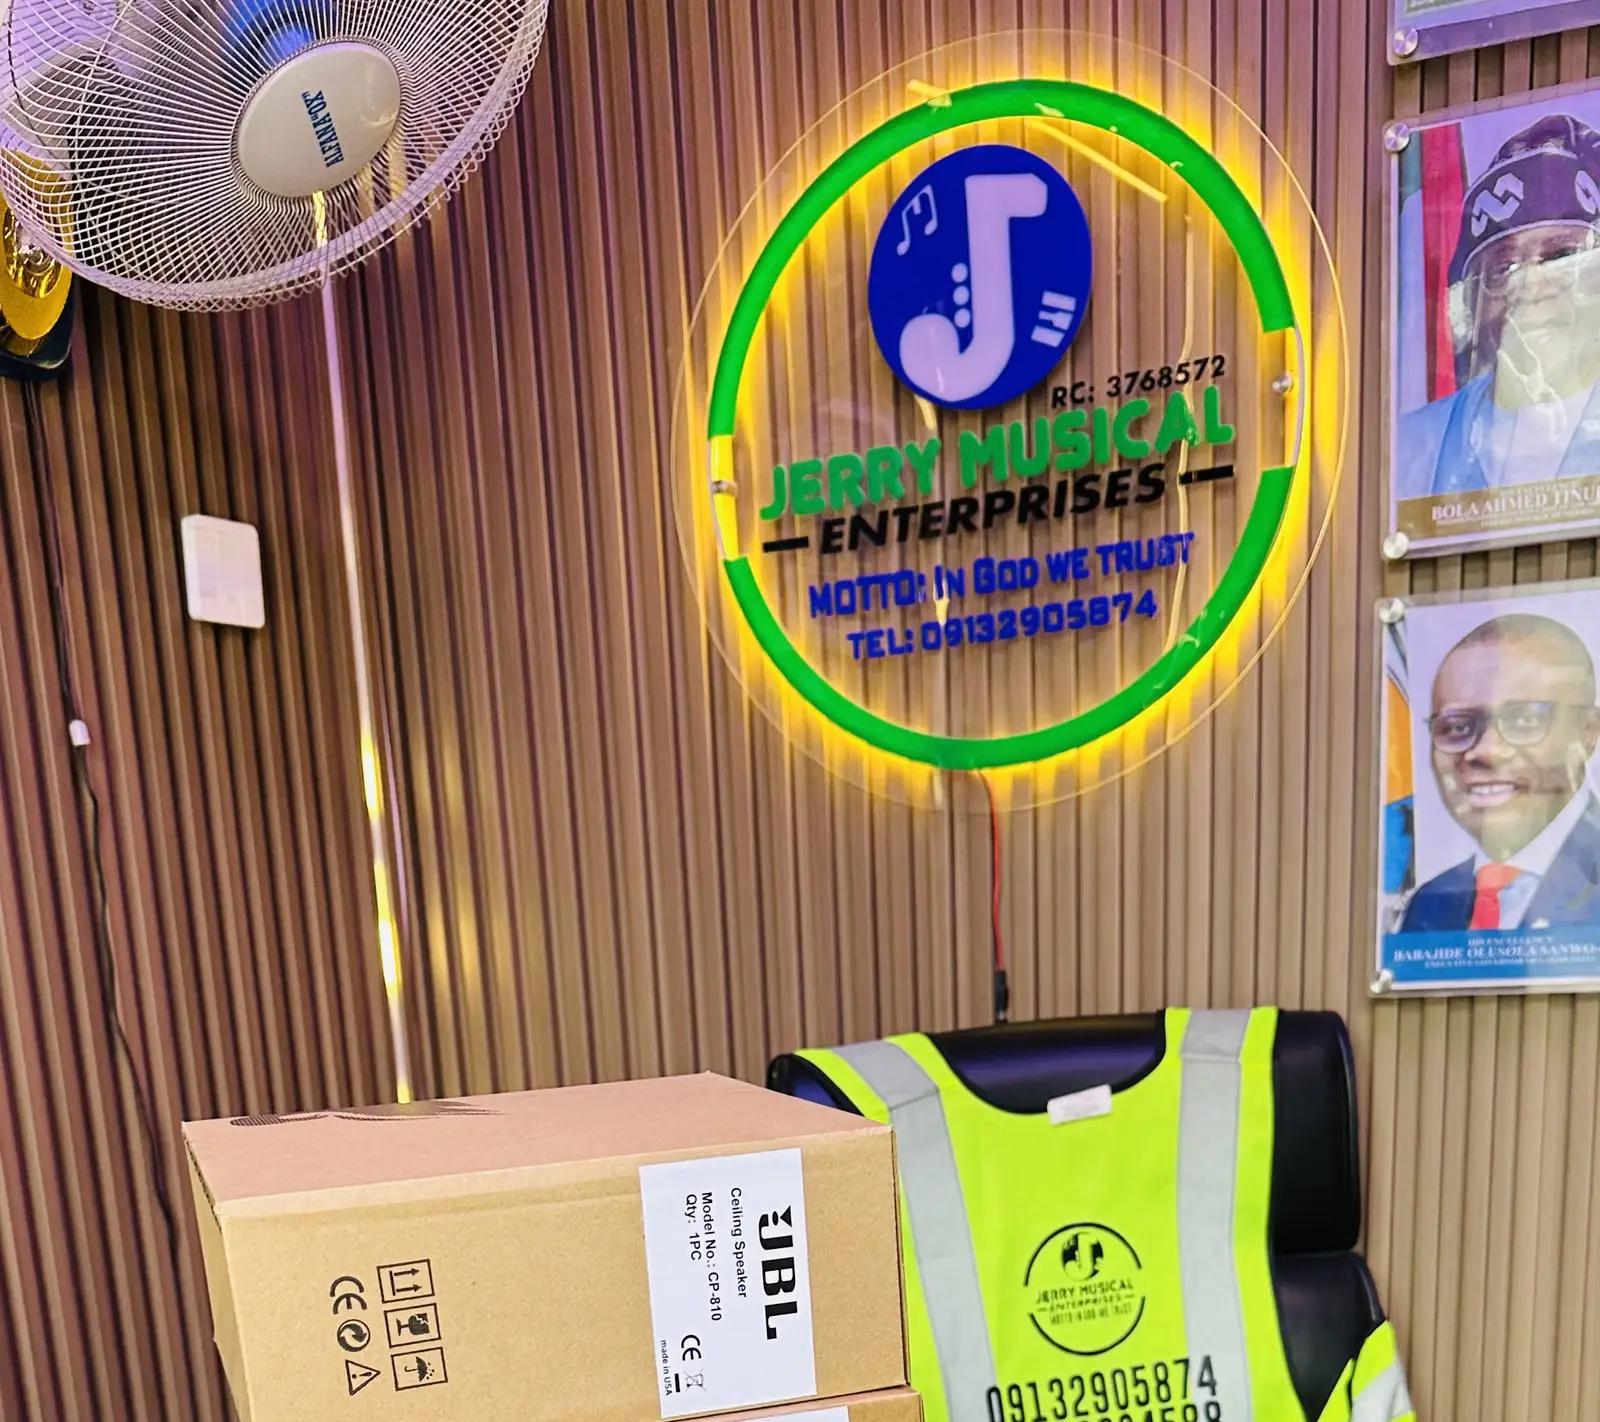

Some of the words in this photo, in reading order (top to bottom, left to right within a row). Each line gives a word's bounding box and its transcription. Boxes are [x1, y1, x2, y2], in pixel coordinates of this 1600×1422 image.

[1051, 379, 1096, 410] RC:
[1106, 354, 1227, 398] 3768572
[759, 436, 942, 523] JERRY
[958, 385, 1236, 488] MUSICAL
[821, 462, 1167, 555] ENTERPRISES
[1431, 503, 1480, 521] BOLA
[808, 568, 927, 619] MOTTO:
[1046, 547, 1090, 583] WE
[1096, 531, 1195, 573] TRUST
[846, 624, 915, 661] TEL:
[921, 588, 1159, 653] 09132905874
[685, 1194, 698, 1225] Qty:
[730, 1187, 743, 1238] Ceiling
[689, 1233, 702, 1261] 1PC
[701, 1191, 715, 1236] Model
[708, 1271, 722, 1322] CP-810
[734, 1241, 748, 1299] Speaker
[758, 1206, 798, 1340] JBL
[1036, 1287, 1075, 1305] JERRY
[1079, 1278, 1134, 1297] MUSICAL
[660, 1339, 669, 1364] made
[663, 1365, 670, 1375] in
[664, 1376, 672, 1397] USA
